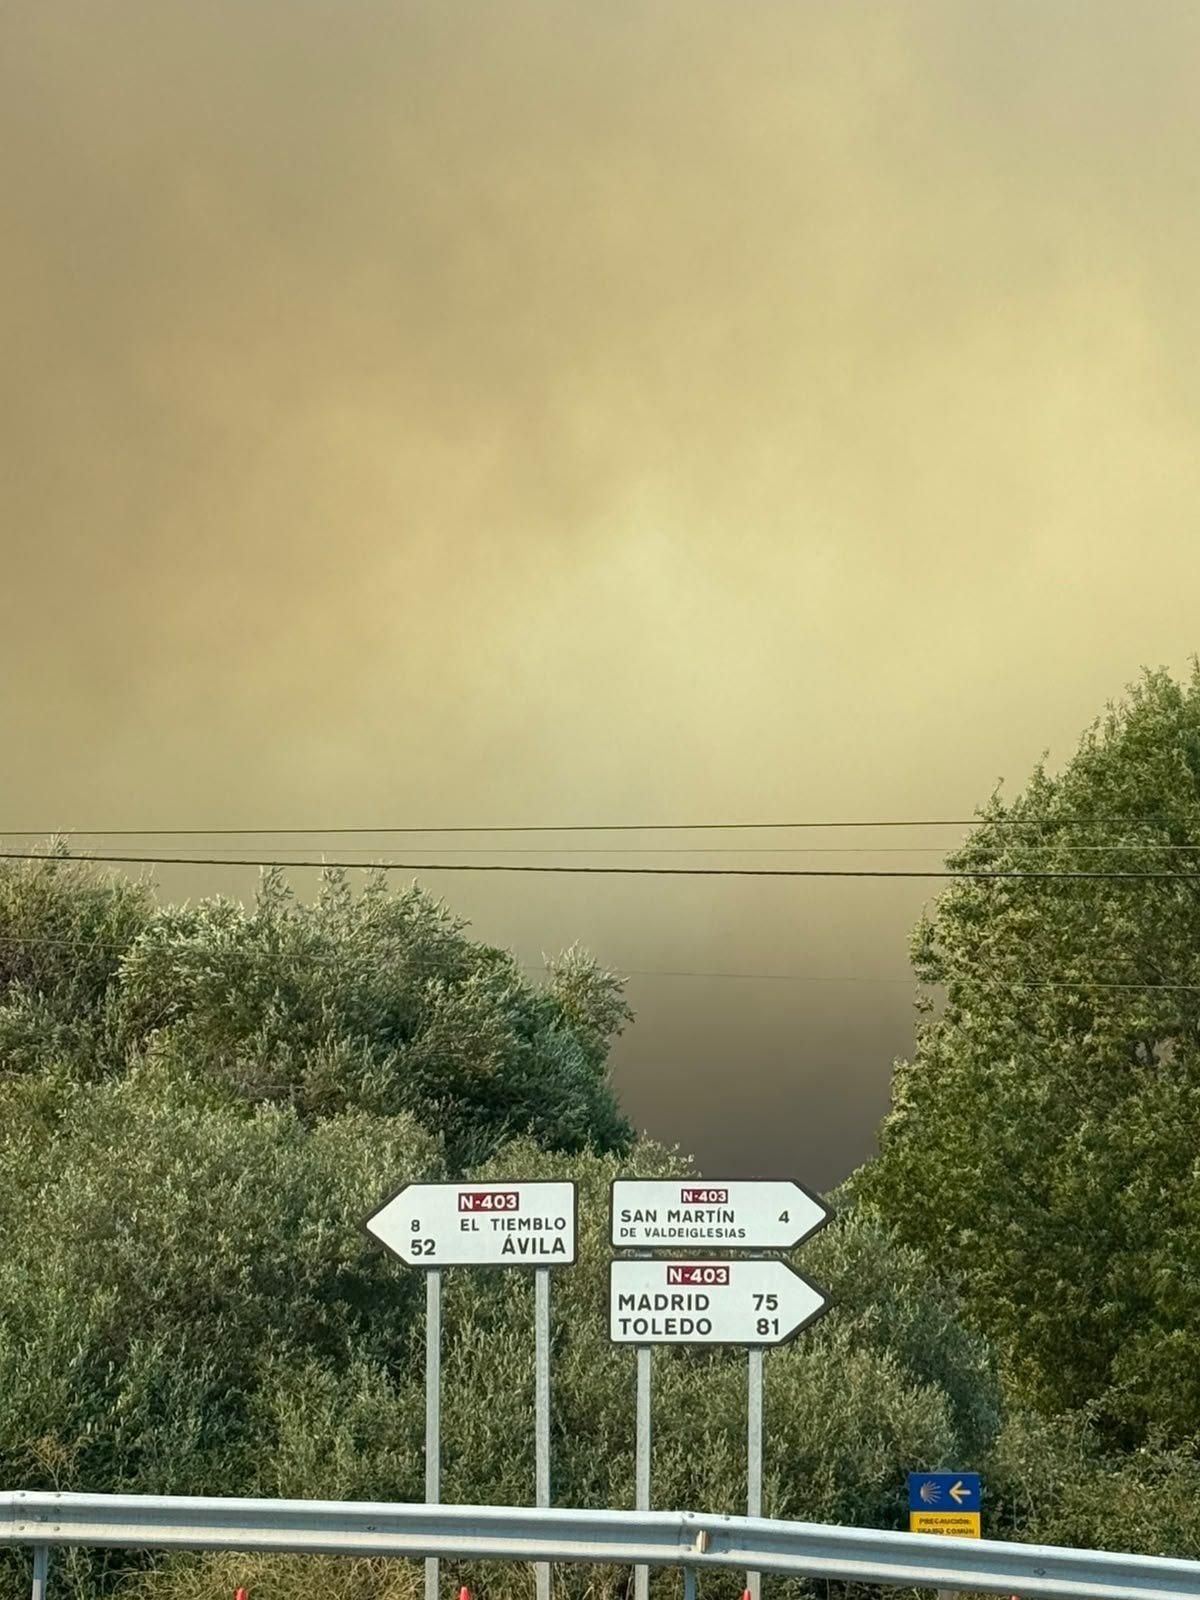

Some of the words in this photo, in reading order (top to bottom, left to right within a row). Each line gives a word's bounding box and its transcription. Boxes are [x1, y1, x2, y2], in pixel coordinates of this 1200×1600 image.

[460, 1194, 517, 1210] N-403
[682, 1191, 727, 1202] N-403
[620, 1209, 657, 1223] SAN
[667, 1207, 735, 1223] MARTÍN
[778, 1210, 790, 1224] 4
[410, 1219, 421, 1232] 8
[460, 1218, 480, 1231] EL
[490, 1217, 566, 1231] TIEMBLO
[620, 1227, 637, 1238] DE
[644, 1227, 746, 1238] VALDEIGLESIAS
[410, 1239, 436, 1256] 52
[501, 1234, 566, 1255] ÁVILA
[669, 1268, 728, 1283] N-403
[618, 1294, 710, 1311] MADRID
[752, 1294, 779, 1311] 75
[618, 1318, 712, 1335] TOLEDO
[756, 1318, 780, 1335] 81
